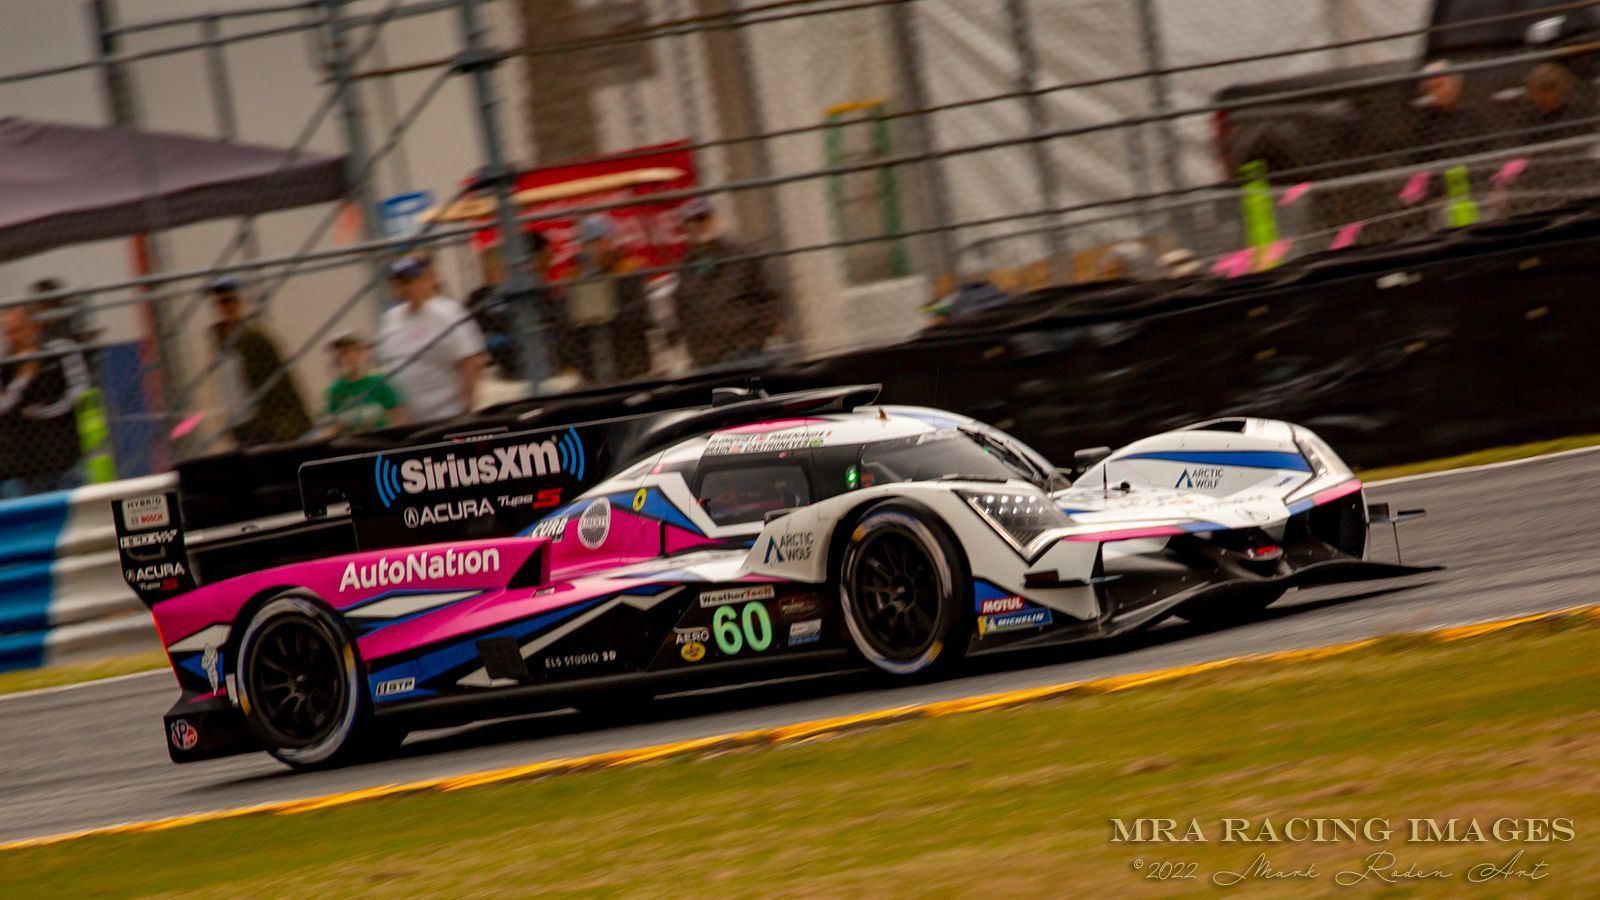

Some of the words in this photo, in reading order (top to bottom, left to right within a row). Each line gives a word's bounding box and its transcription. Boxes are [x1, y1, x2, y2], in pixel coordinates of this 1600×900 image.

[744, 439, 809, 453] CASTRONEVES
[1192, 467, 1224, 479] ARCTIC
[1195, 478, 1219, 489] WOLF
[127, 497, 162, 509] HYBRID
[420, 496, 496, 527] ACURA
[533, 487, 563, 510] S
[532, 514, 570, 540] CURB
[780, 531, 814, 548] ARCTIC
[785, 546, 813, 561] WOLF
[136, 561, 186, 582] ACURA
[338, 547, 500, 593] AutoNation
[702, 586, 774, 605] WeatherTech
[982, 596, 1023, 614] MOTUL
[713, 600, 773, 656] 60
[997, 612, 1045, 627] MICHELIN
[564, 652, 599, 667] STUDIO
